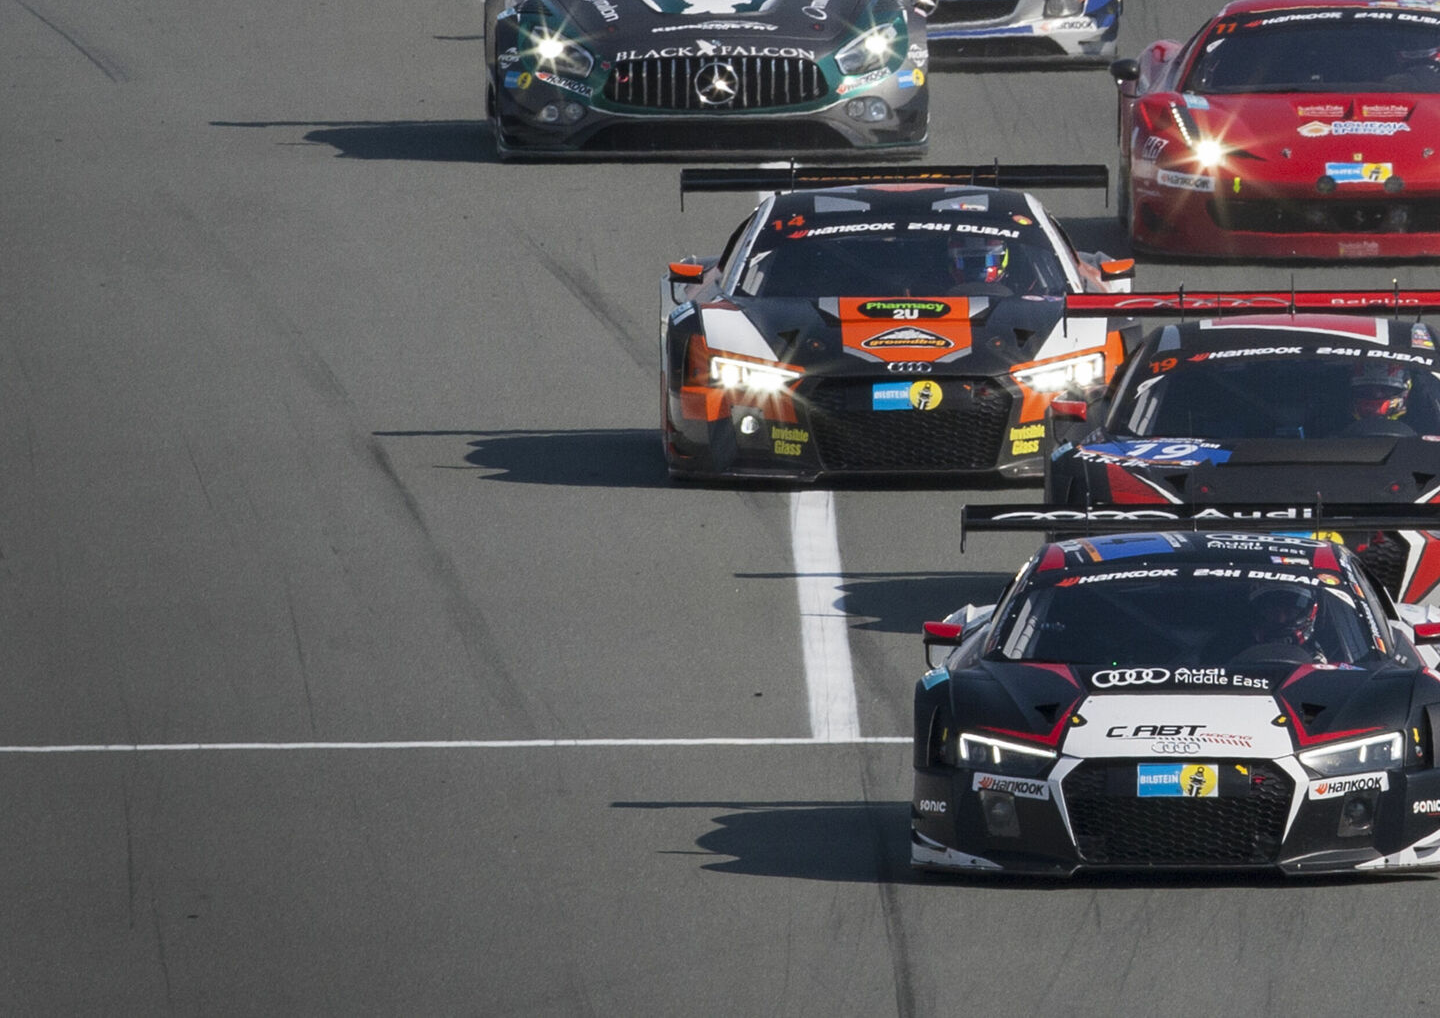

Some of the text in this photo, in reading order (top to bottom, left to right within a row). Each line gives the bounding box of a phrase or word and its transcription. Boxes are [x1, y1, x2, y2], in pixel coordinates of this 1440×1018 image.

[1214, 23, 1238, 35] 11
[1353, 11, 1394, 21] 24H
[615, 44, 816, 62] BLACK FALCON
[771, 215, 806, 231] 14
[906, 221, 951, 232] 24H
[955, 223, 1021, 239] DUBAI
[865, 301, 945, 313] Pharmacy
[1330, 297, 1420, 306] Belgian
[892, 309, 920, 320] 2U
[1149, 357, 1179, 374] 19
[1315, 346, 1362, 358] 24H
[1366, 349, 1434, 367] DUBAI
[771, 425, 809, 444] Invisible
[773, 439, 802, 457] Glass
[1011, 439, 1040, 457] Glass
[1125, 442, 1200, 461] 19
[1193, 507, 1313, 521] Audi
[1267, 545, 1307, 555] East
[1192, 567, 1242, 578] 24H
[1247, 570, 1320, 586] DUBAI
[1174, 667, 1226, 676] Audi
[1174, 673, 1270, 690] Middle East
[1138, 773, 1180, 785] BILSTEIN
